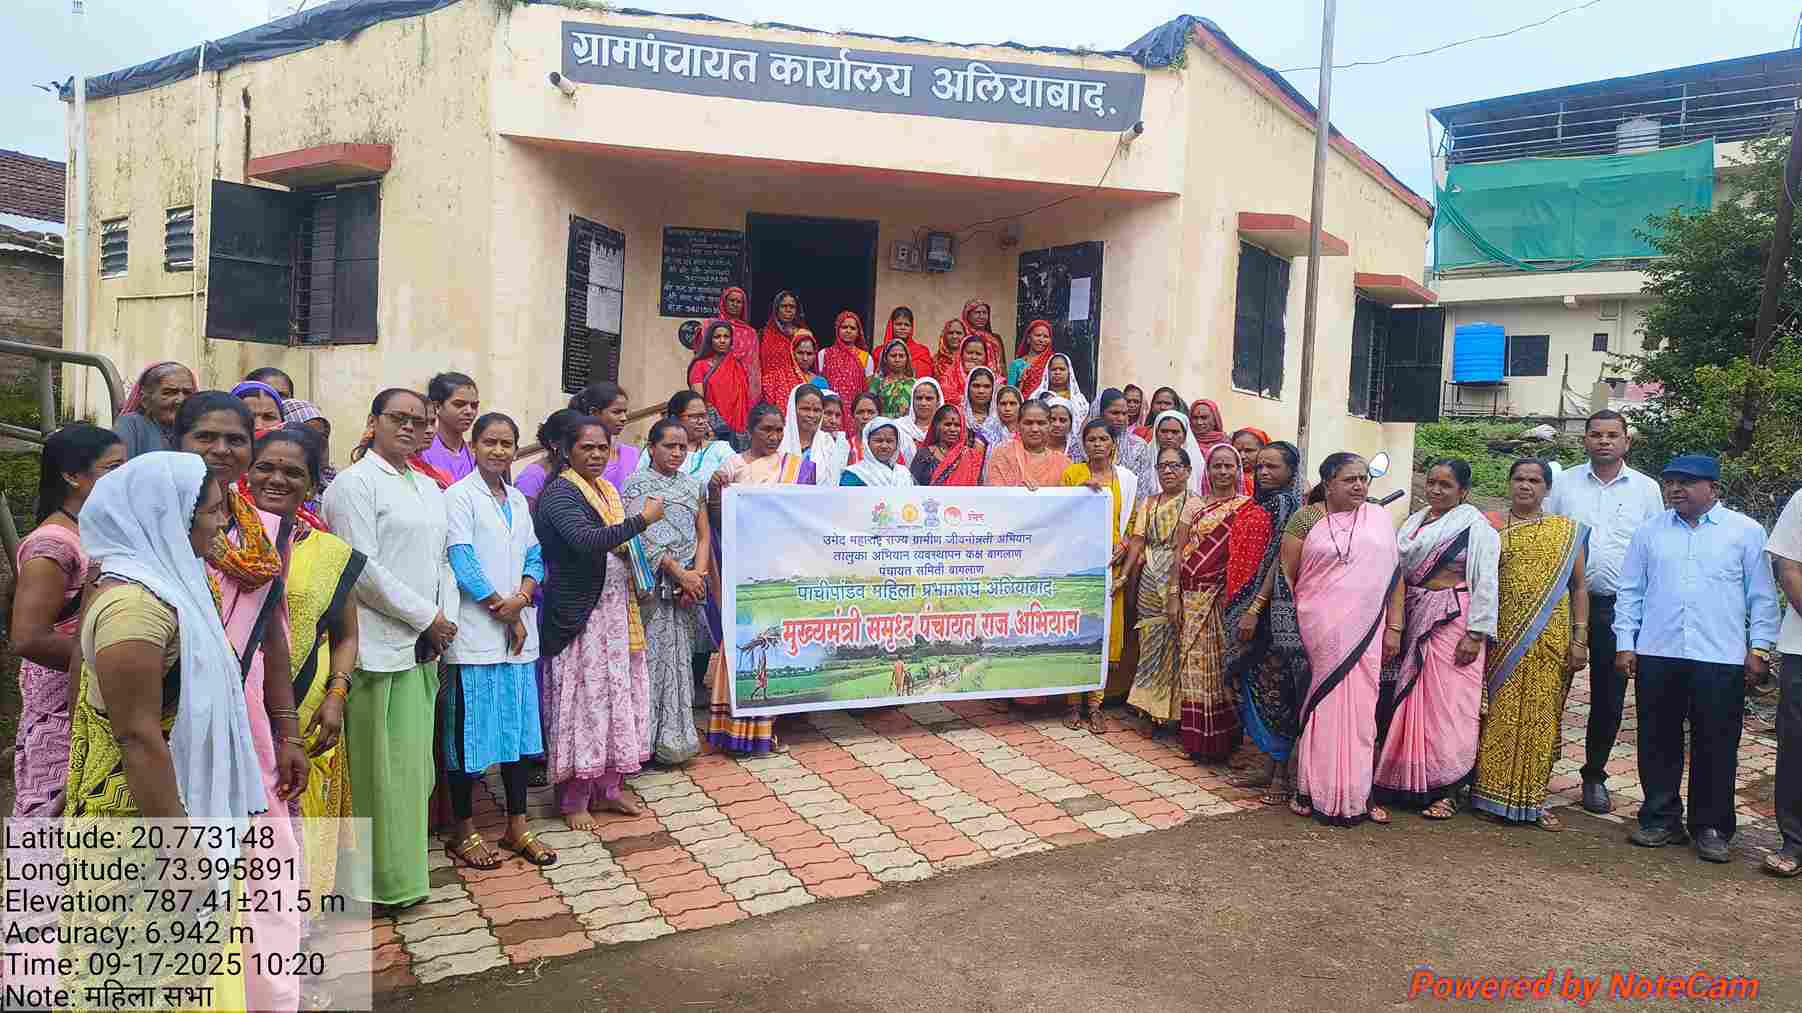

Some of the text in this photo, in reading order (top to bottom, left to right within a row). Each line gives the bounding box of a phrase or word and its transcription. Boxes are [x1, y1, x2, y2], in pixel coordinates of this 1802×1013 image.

[570, 31, 757, 83] ग्रामपंचायत
[769, 48, 912, 97] कार्यालय
[823, 532, 846, 546] उमेद
[833, 551, 867, 565] तालुका
[872, 548, 909, 561] अभियान
[873, 577, 916, 600] महिला
[919, 603, 977, 640] पंचायत
[1014, 600, 1080, 637] अभियान
